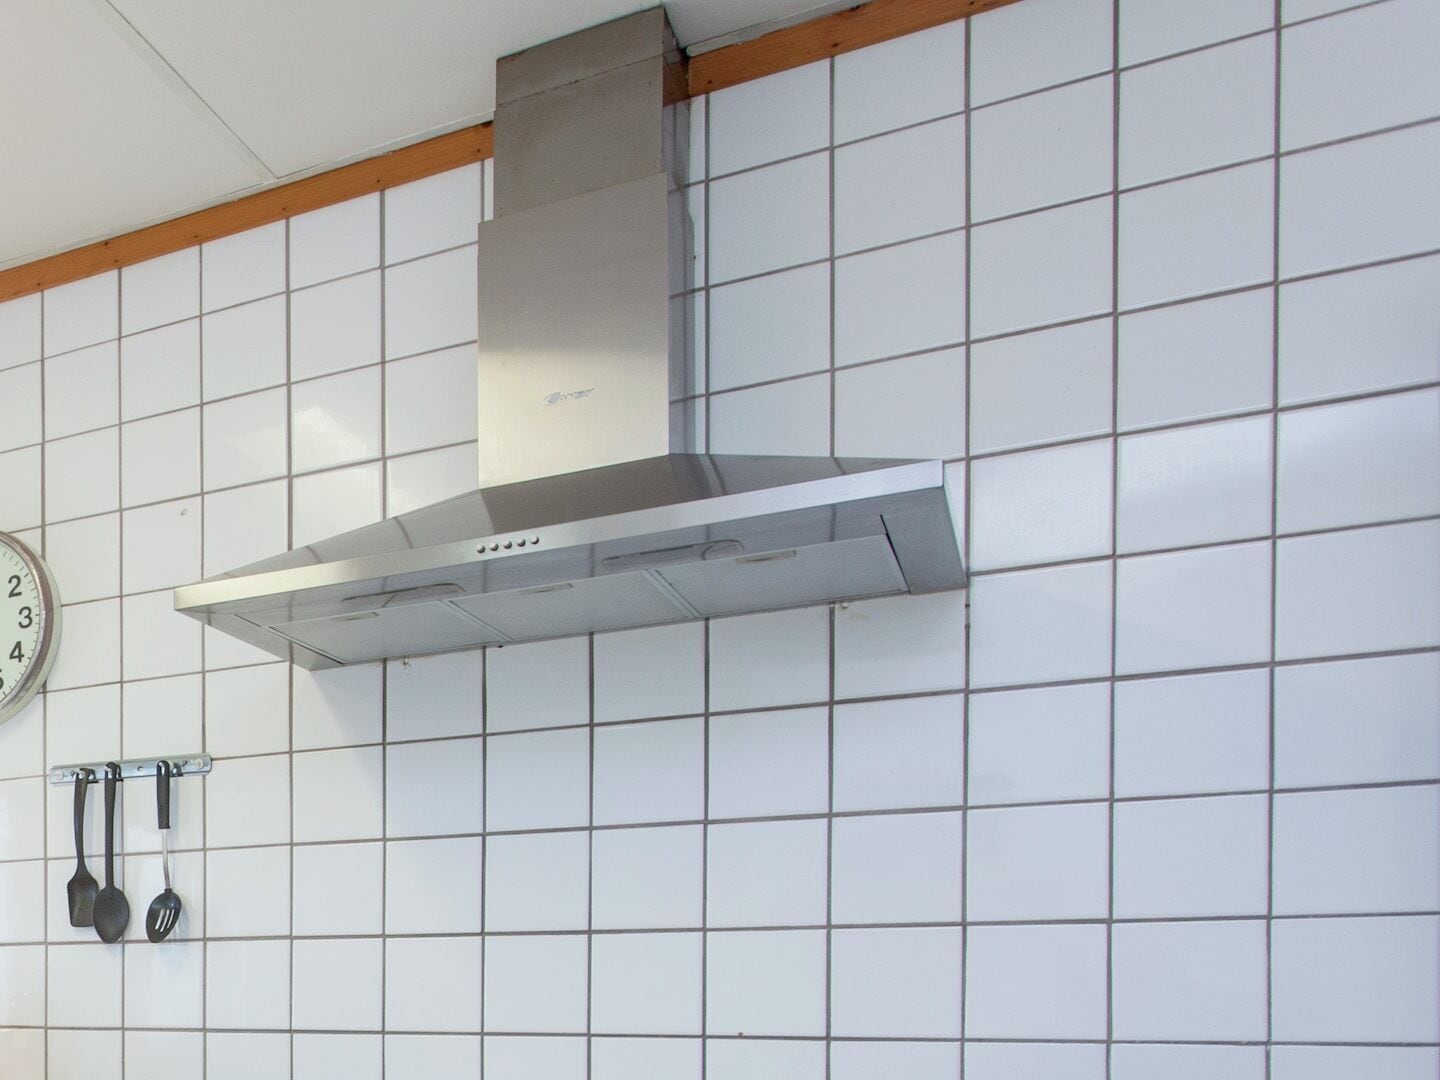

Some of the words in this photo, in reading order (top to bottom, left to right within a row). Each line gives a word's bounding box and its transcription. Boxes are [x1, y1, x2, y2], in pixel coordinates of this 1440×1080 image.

[7, 575, 23, 598] 2
[18, 606, 33, 629] 3
[9, 640, 25, 663] 4
